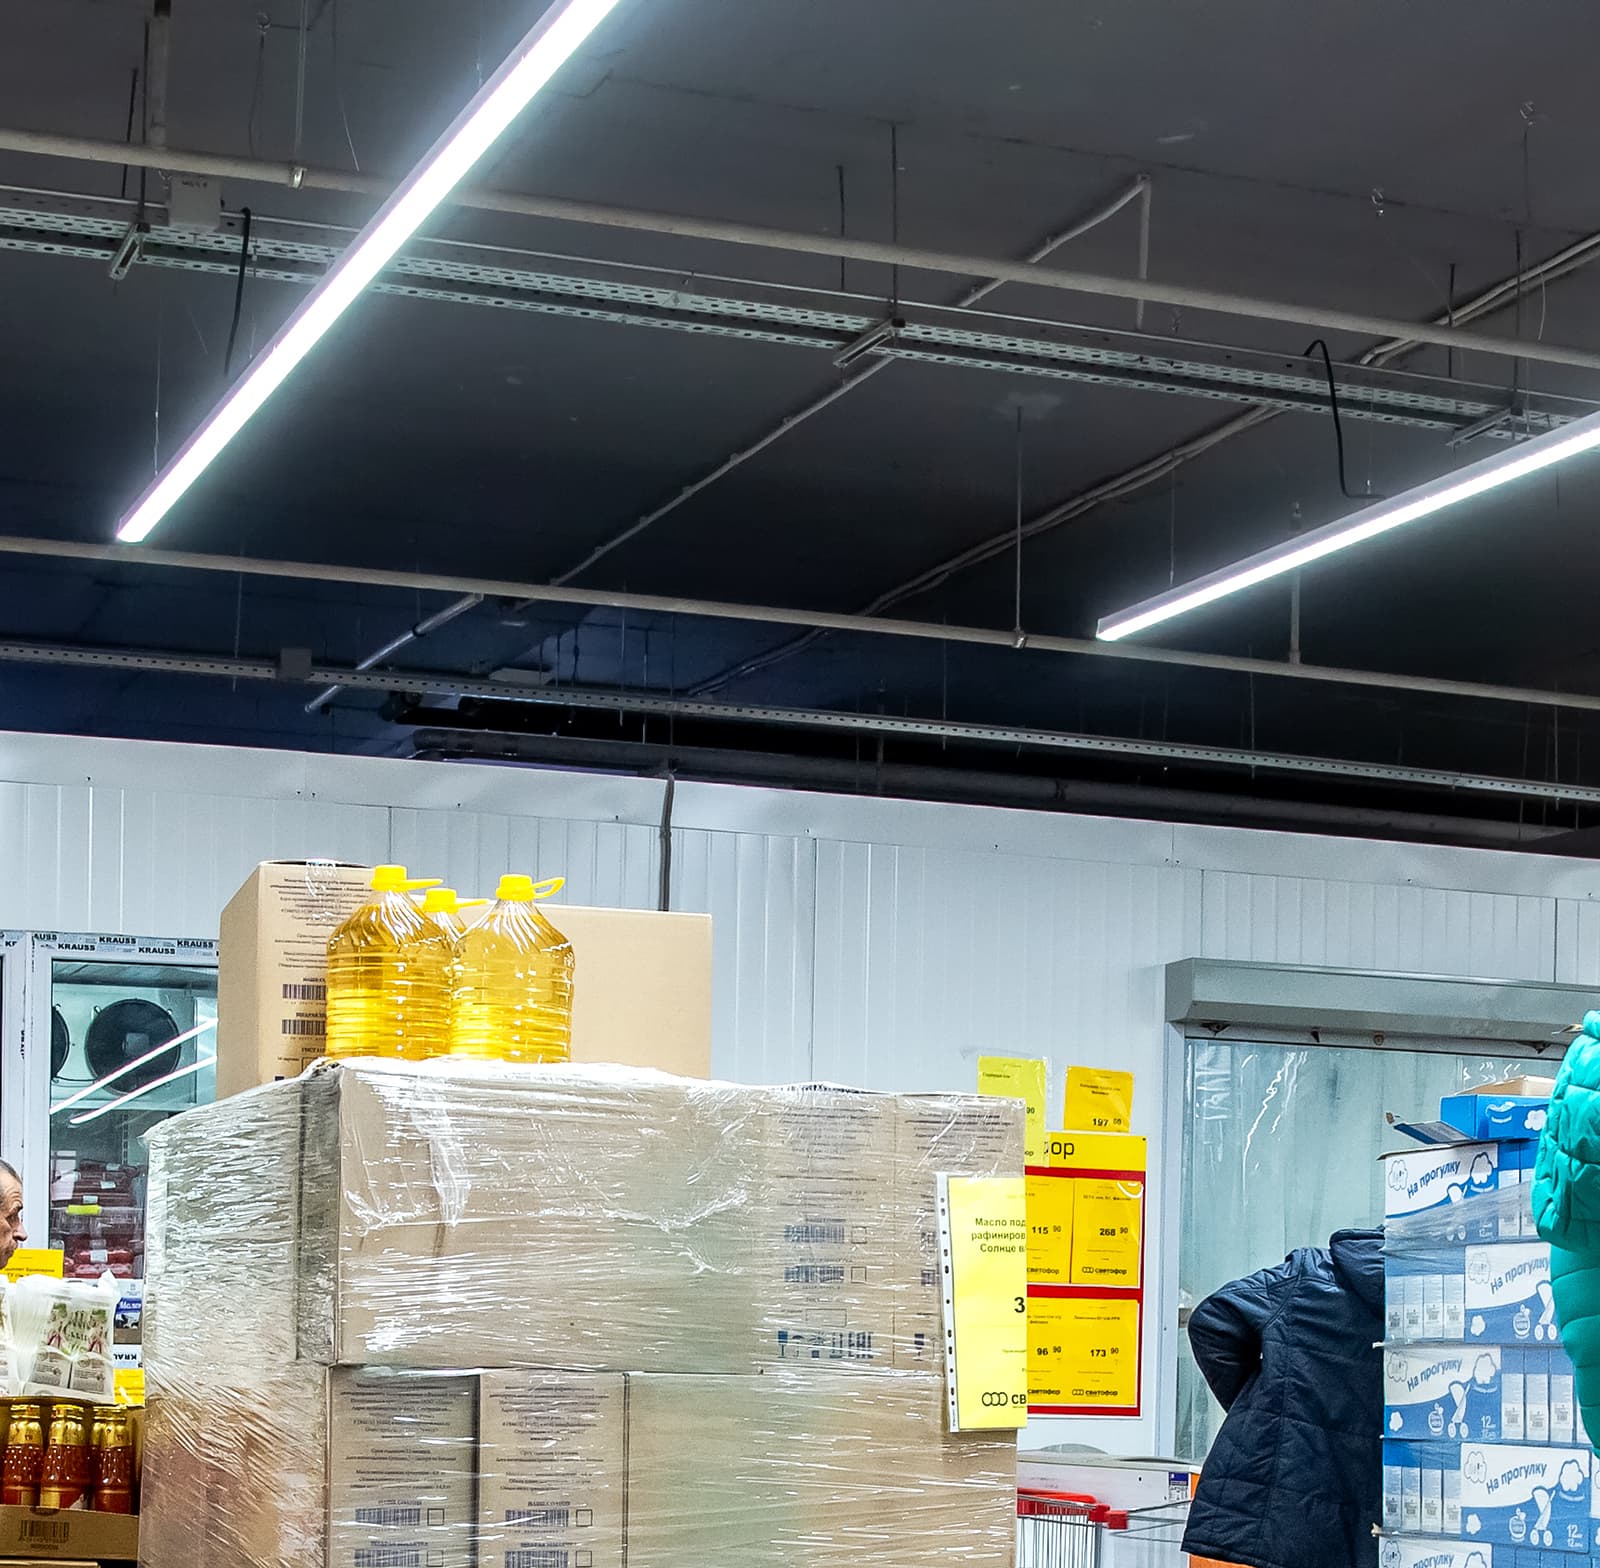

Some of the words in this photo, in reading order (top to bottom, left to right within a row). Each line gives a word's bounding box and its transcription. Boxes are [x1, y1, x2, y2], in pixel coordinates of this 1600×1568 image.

[58, 943, 95, 951] KRAUSS
[177, 940, 213, 948] KRAUSS
[1093, 1118, 1108, 1127] 197
[1406, 1178, 1418, 1199] На
[1419, 1158, 1461, 1189] прогулку
[975, 1217, 1006, 1227] Масло
[1032, 1226, 1048, 1234] 115
[1099, 1228, 1116, 1236] 268
[971, 1230, 1026, 1243] рафиниров
[980, 1243, 1016, 1254] Солнце
[1490, 1274, 1504, 1295] На
[1504, 1250, 1551, 1286] прогулку
[1037, 1348, 1048, 1356] 96
[1090, 1349, 1106, 1357] 173
[1406, 1372, 1418, 1392] На
[1419, 1359, 1463, 1385] прогулку
[1486, 1473, 1499, 1494] На
[1500, 1461, 1548, 1488] прогулку
[1566, 1524, 1578, 1538] 12
